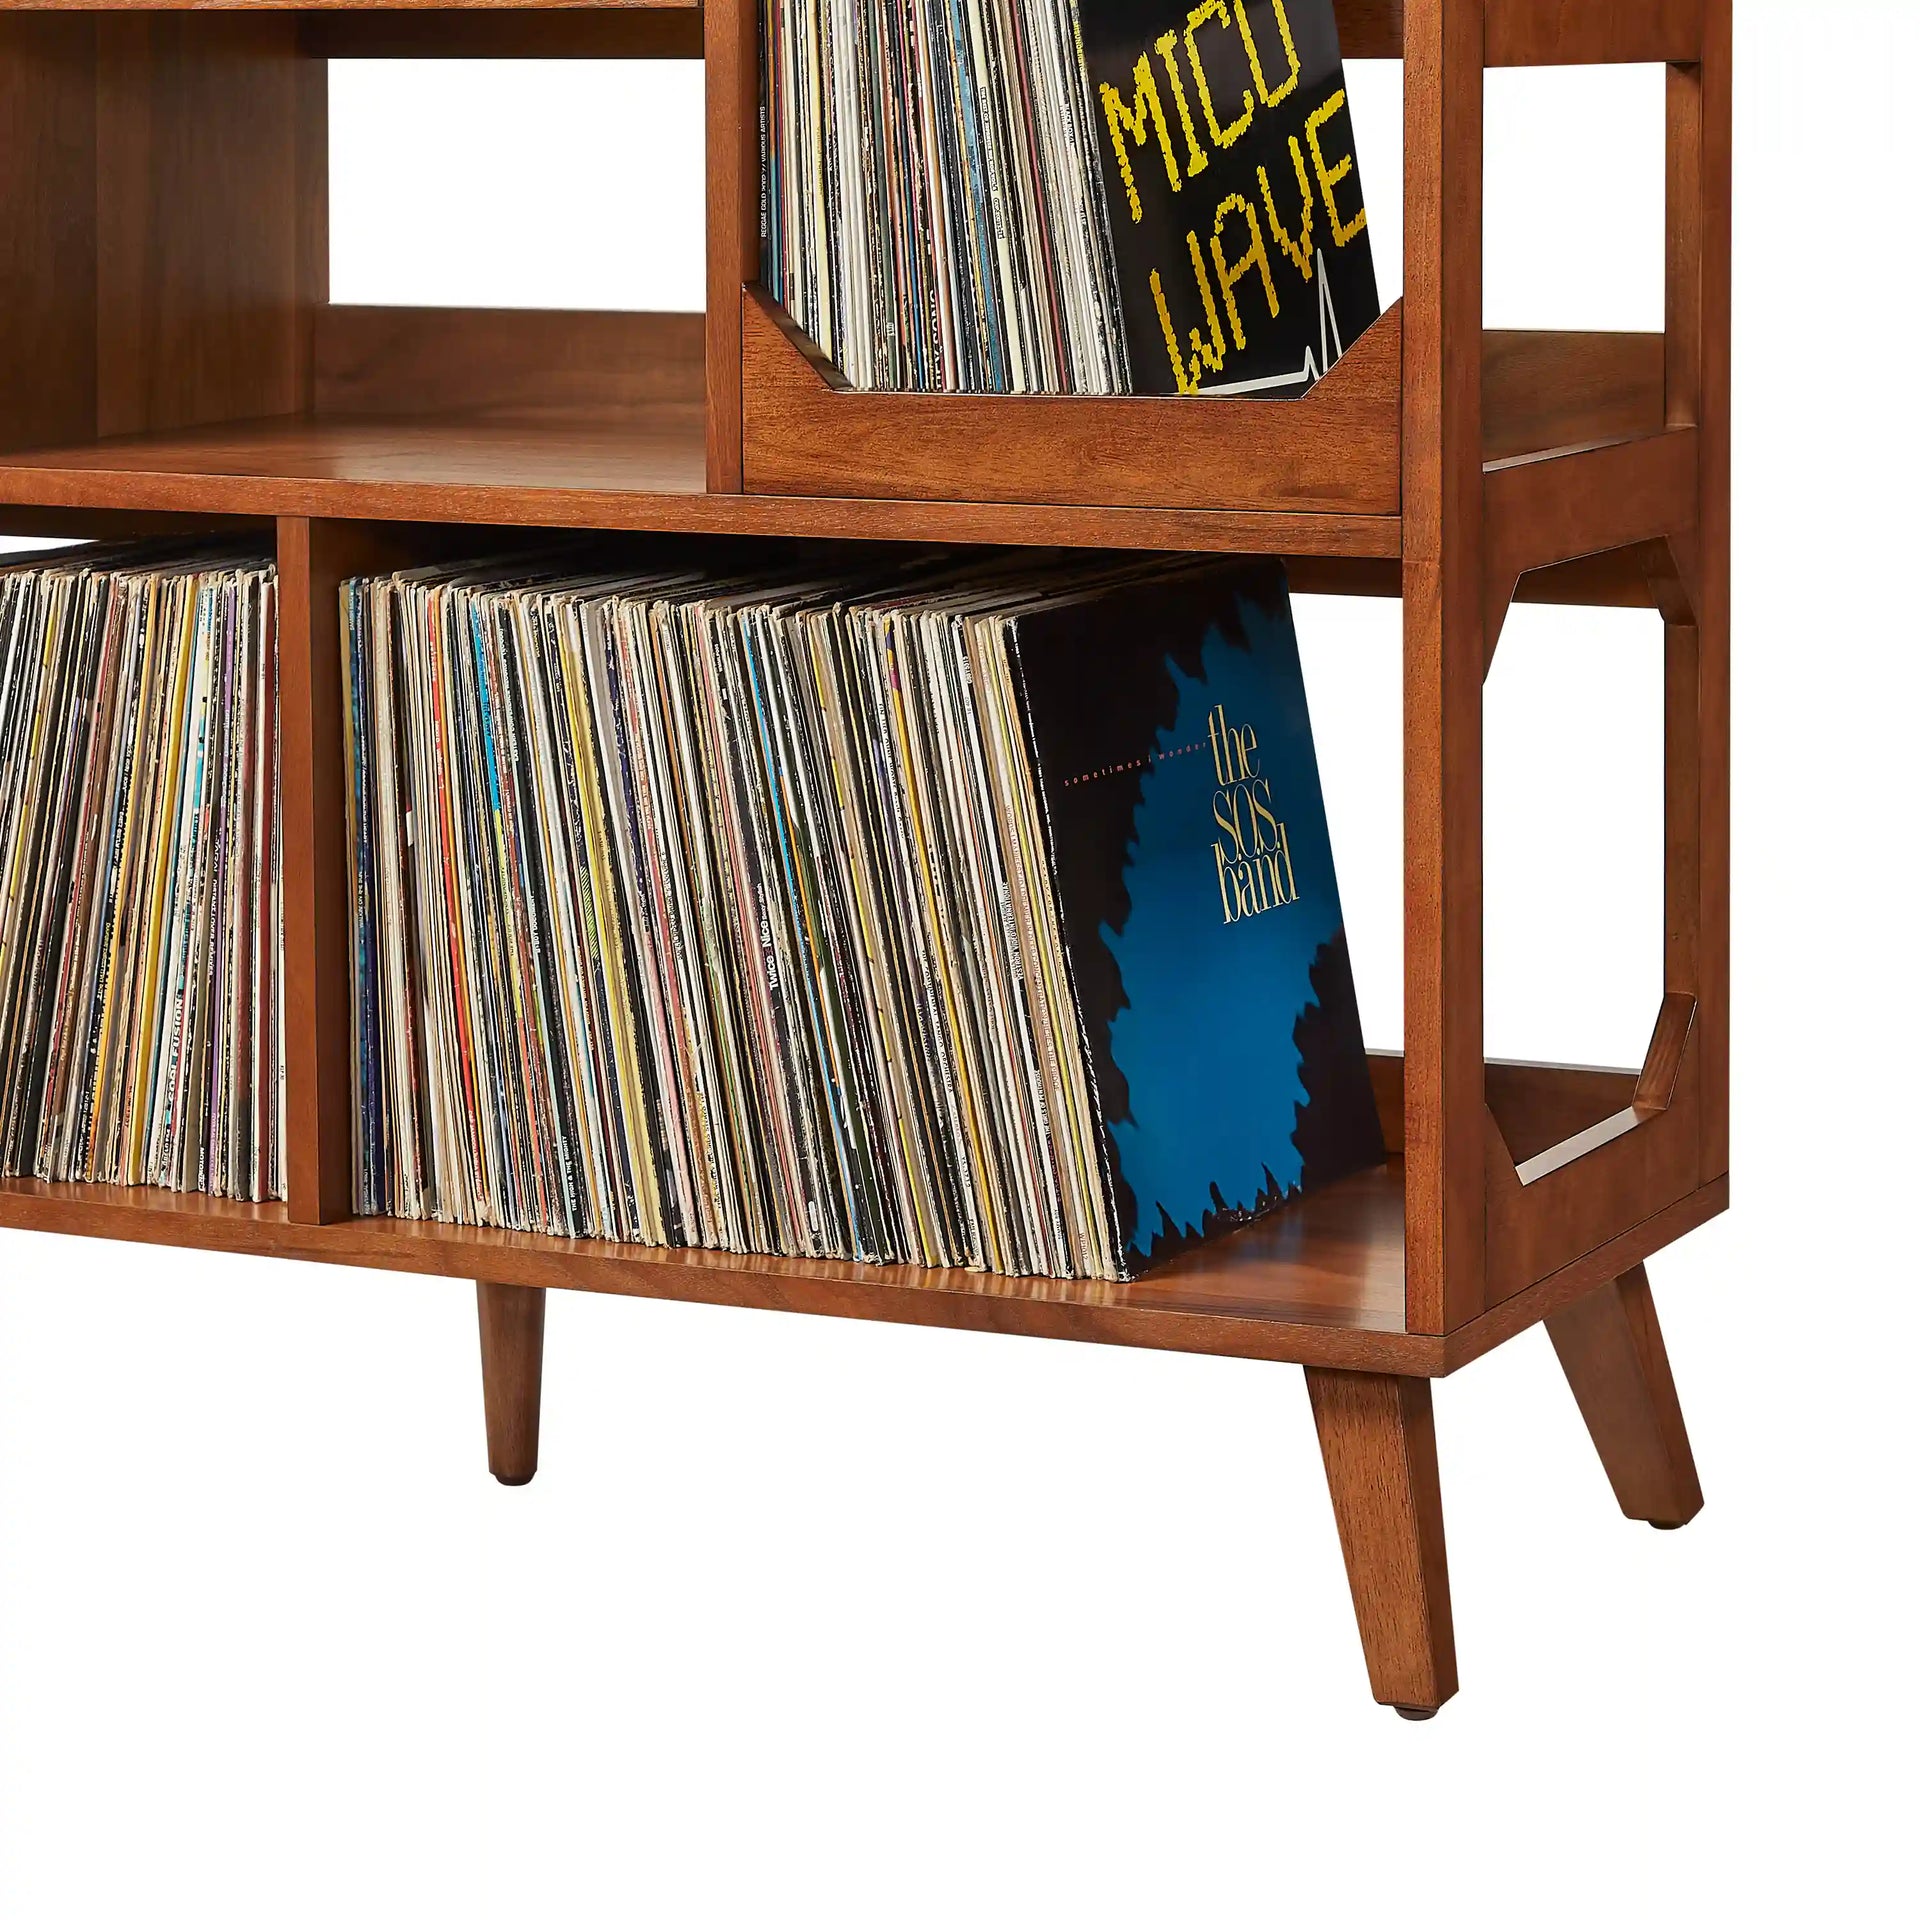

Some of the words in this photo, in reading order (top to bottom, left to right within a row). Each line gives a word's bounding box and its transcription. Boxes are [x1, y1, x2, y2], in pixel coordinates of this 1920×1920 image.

[759, 133, 767, 161] VARIOUS
[759, 211, 767, 237] REGGAE
[1149, 89, 1367, 395] WAVE
[1208, 704, 1260, 786] the
[1064, 758, 1141, 787] sometimes
[1157, 741, 1206, 761] wonder
[1004, 804, 1016, 833] WORDS
[1010, 837, 1023, 876] MANIFEST
[1211, 822, 1300, 925] band
[998, 880, 1020, 931] INTERNATIONAL
[759, 919, 772, 947] Nice
[1008, 929, 1020, 949] VIDEO
[1027, 932, 1036, 953] DEEP
[764, 954, 779, 990] Twice
[1011, 950, 1026, 980] VESTRON
[1030, 954, 1047, 1018] CONCENTRATION
[170, 997, 183, 1057] FUSION
[1046, 1049, 1056, 1064] THE
[938, 1050, 955, 1094] ORCHESTRA
[1033, 1068, 1045, 1100] PENTHOUSE
[1049, 1065, 1061, 1091] PROOF
[1040, 1107, 1050, 1124] GIRLS
[561, 1134, 570, 1160] MIGHTY
[564, 1159, 572, 1173] THE
[567, 1180, 576, 1198] HIGH
